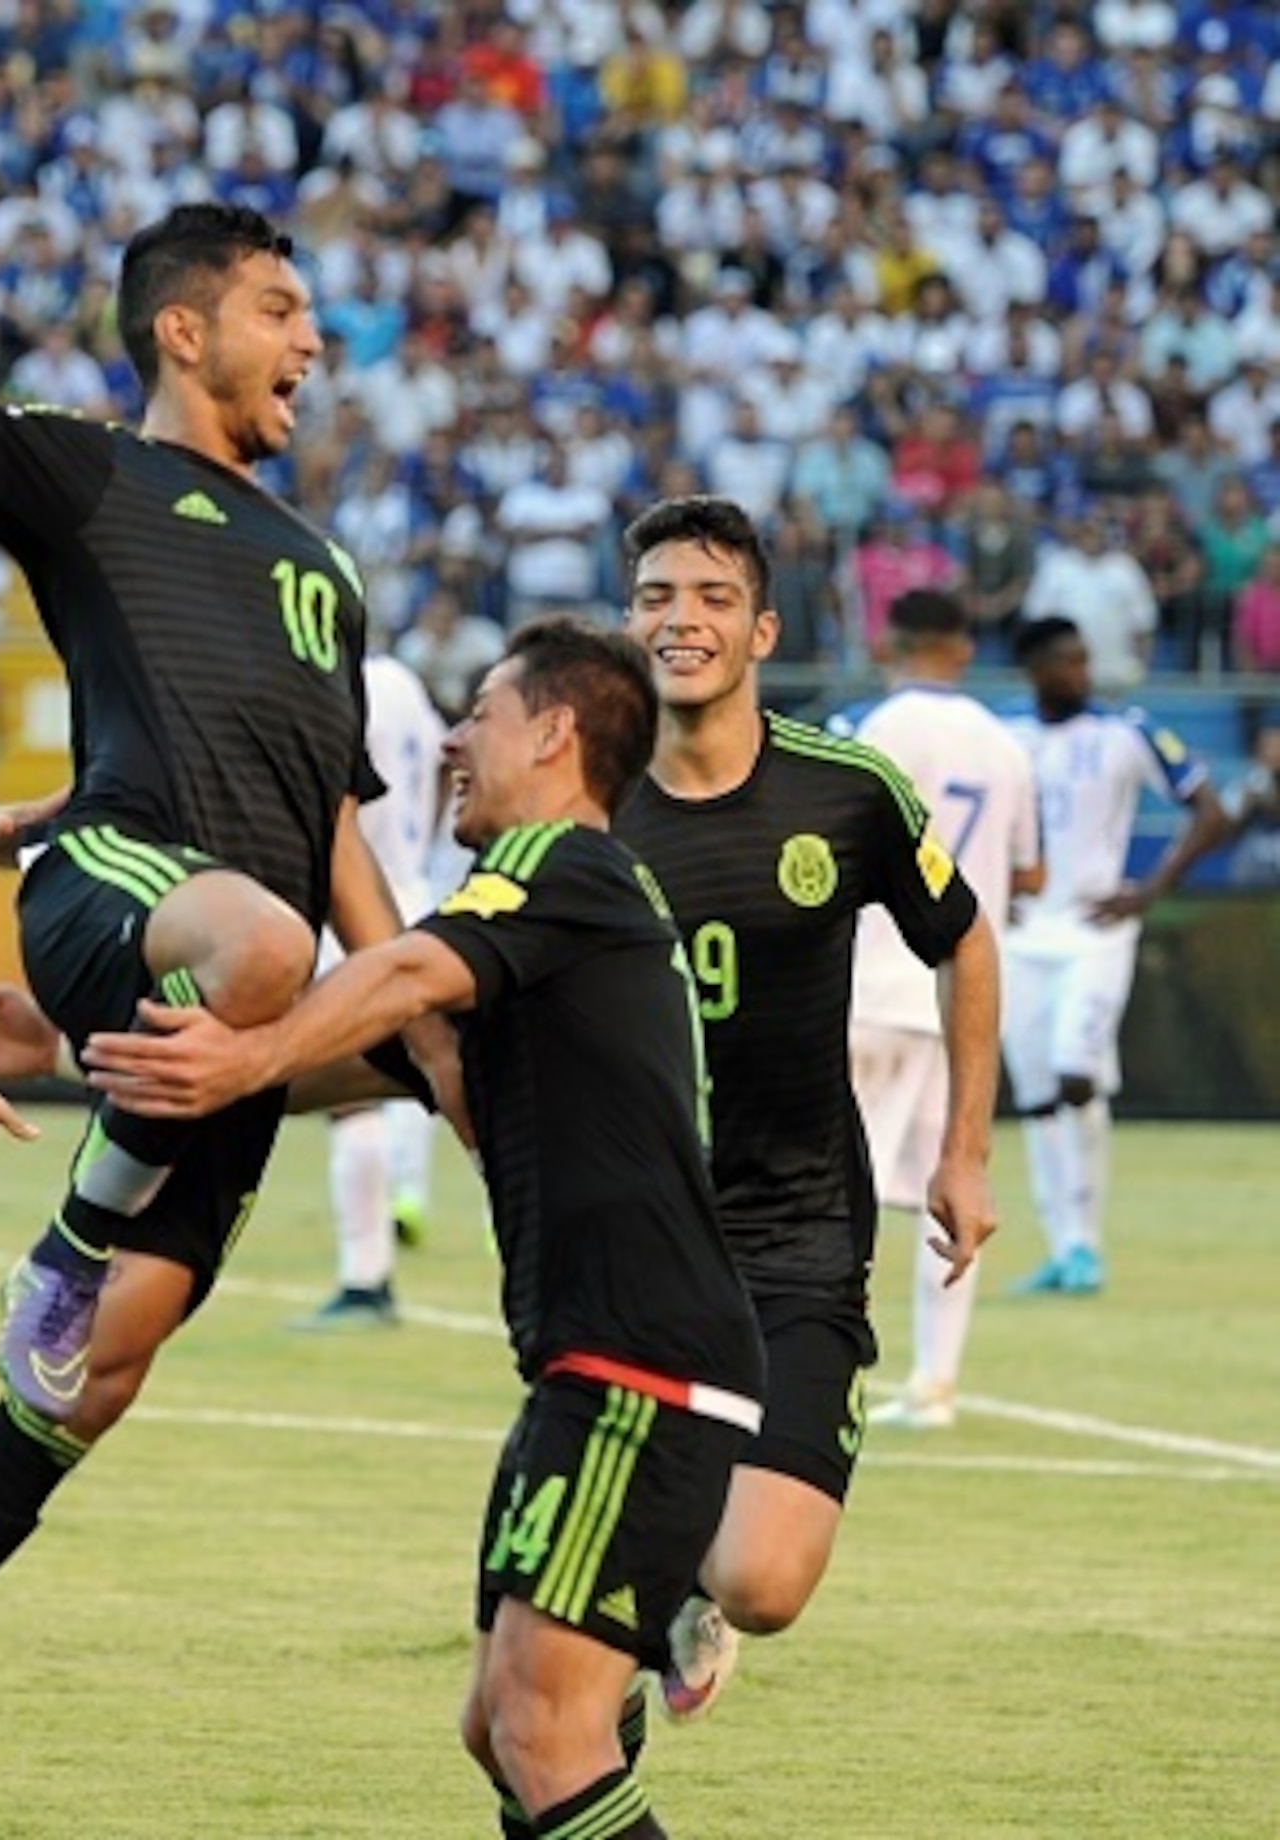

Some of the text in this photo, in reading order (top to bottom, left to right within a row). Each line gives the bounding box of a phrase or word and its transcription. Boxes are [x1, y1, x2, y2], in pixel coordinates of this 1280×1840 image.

[272, 559, 338, 674] 10
[943, 780, 987, 860] 7
[693, 920, 738, 1019] 9
[485, 1474, 567, 1574] 14
